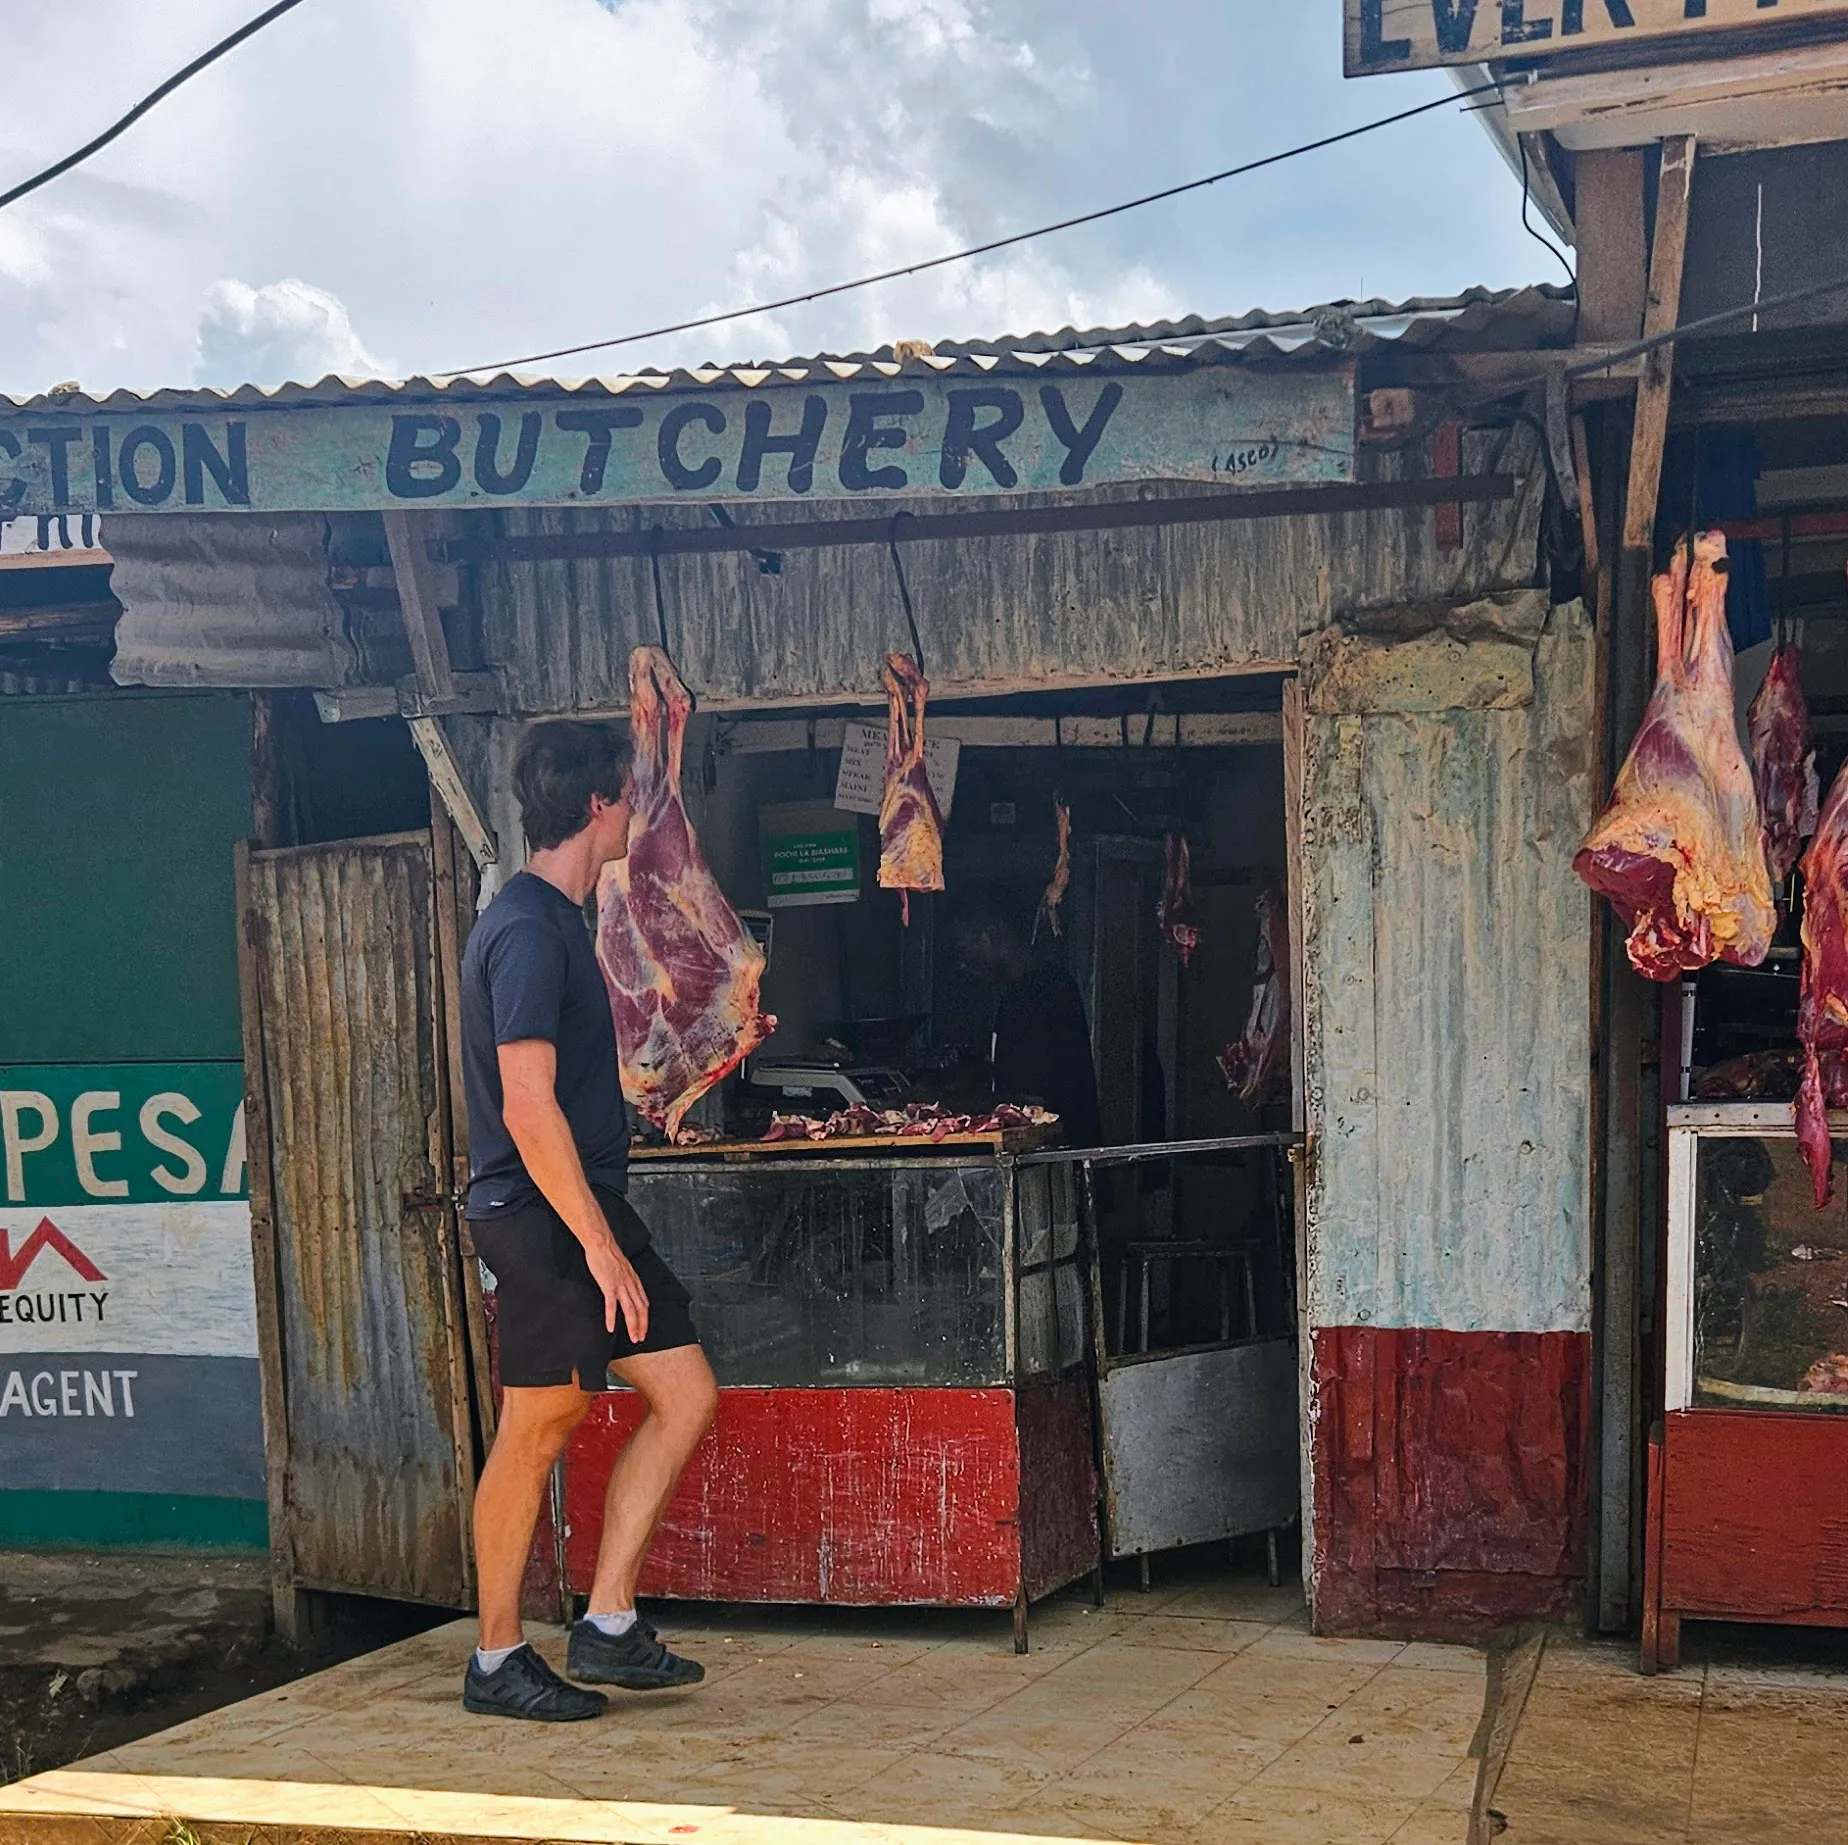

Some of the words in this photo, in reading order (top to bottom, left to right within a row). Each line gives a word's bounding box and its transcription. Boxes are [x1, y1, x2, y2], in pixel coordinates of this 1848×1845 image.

[385, 382, 1124, 499] BUTCHERY
[0, 1291, 109, 1324] EQUITY
[0, 1369, 138, 1418] AGENT
